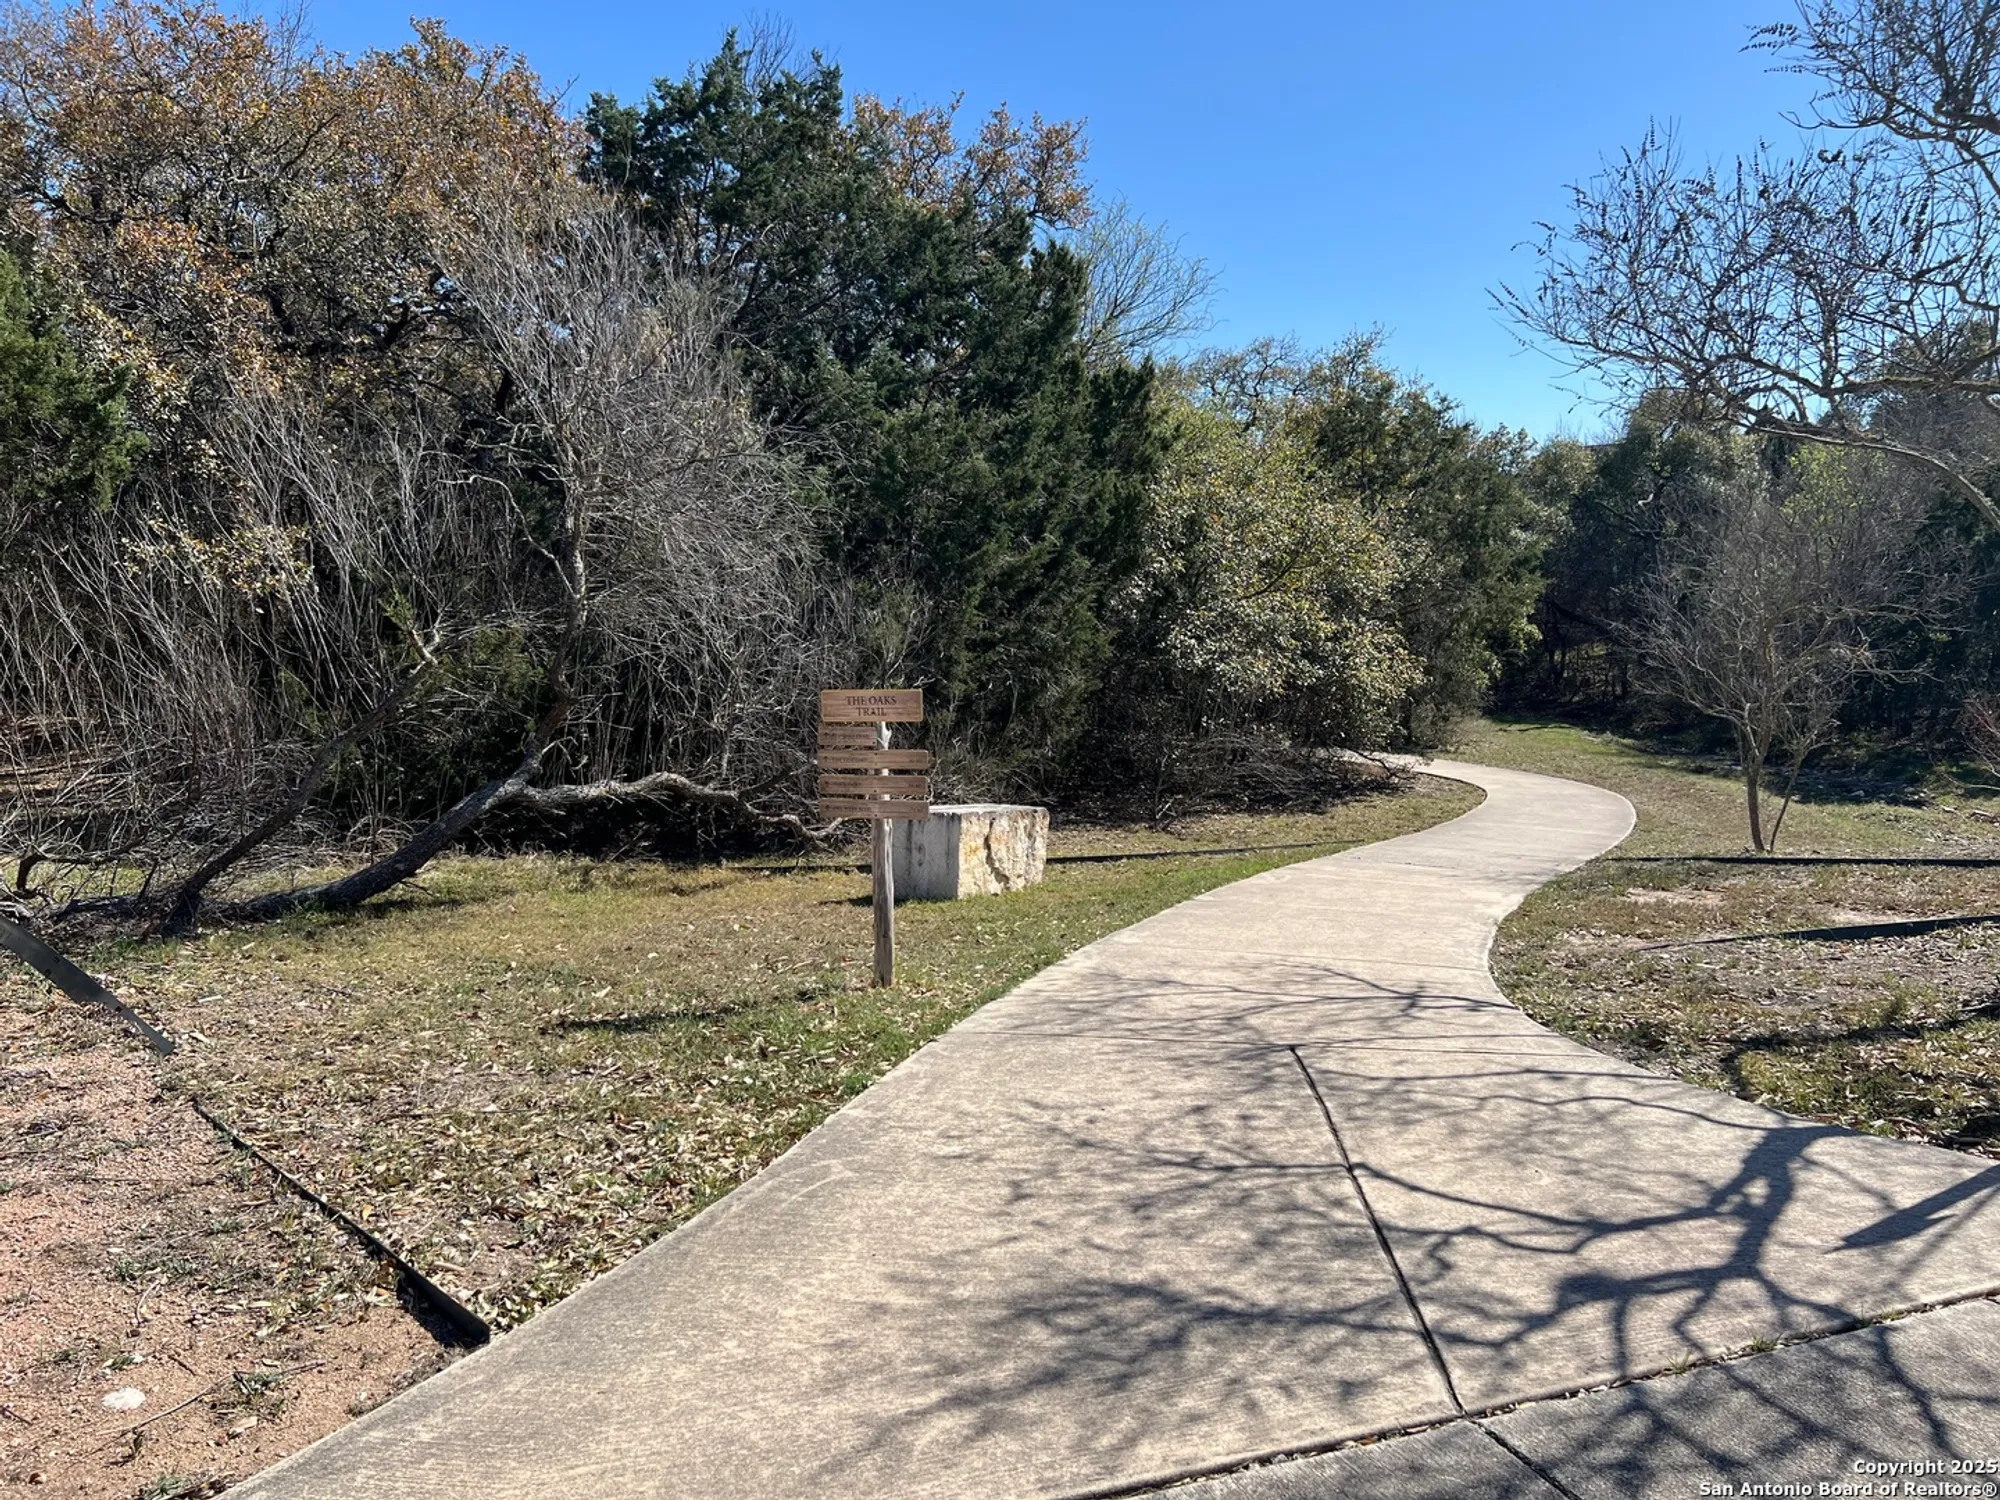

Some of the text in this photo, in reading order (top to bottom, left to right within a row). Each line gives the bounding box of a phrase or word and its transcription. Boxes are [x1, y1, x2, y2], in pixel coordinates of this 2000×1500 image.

[846, 696, 897, 705] THE OAKS
[856, 707, 887, 716] TRAIL
